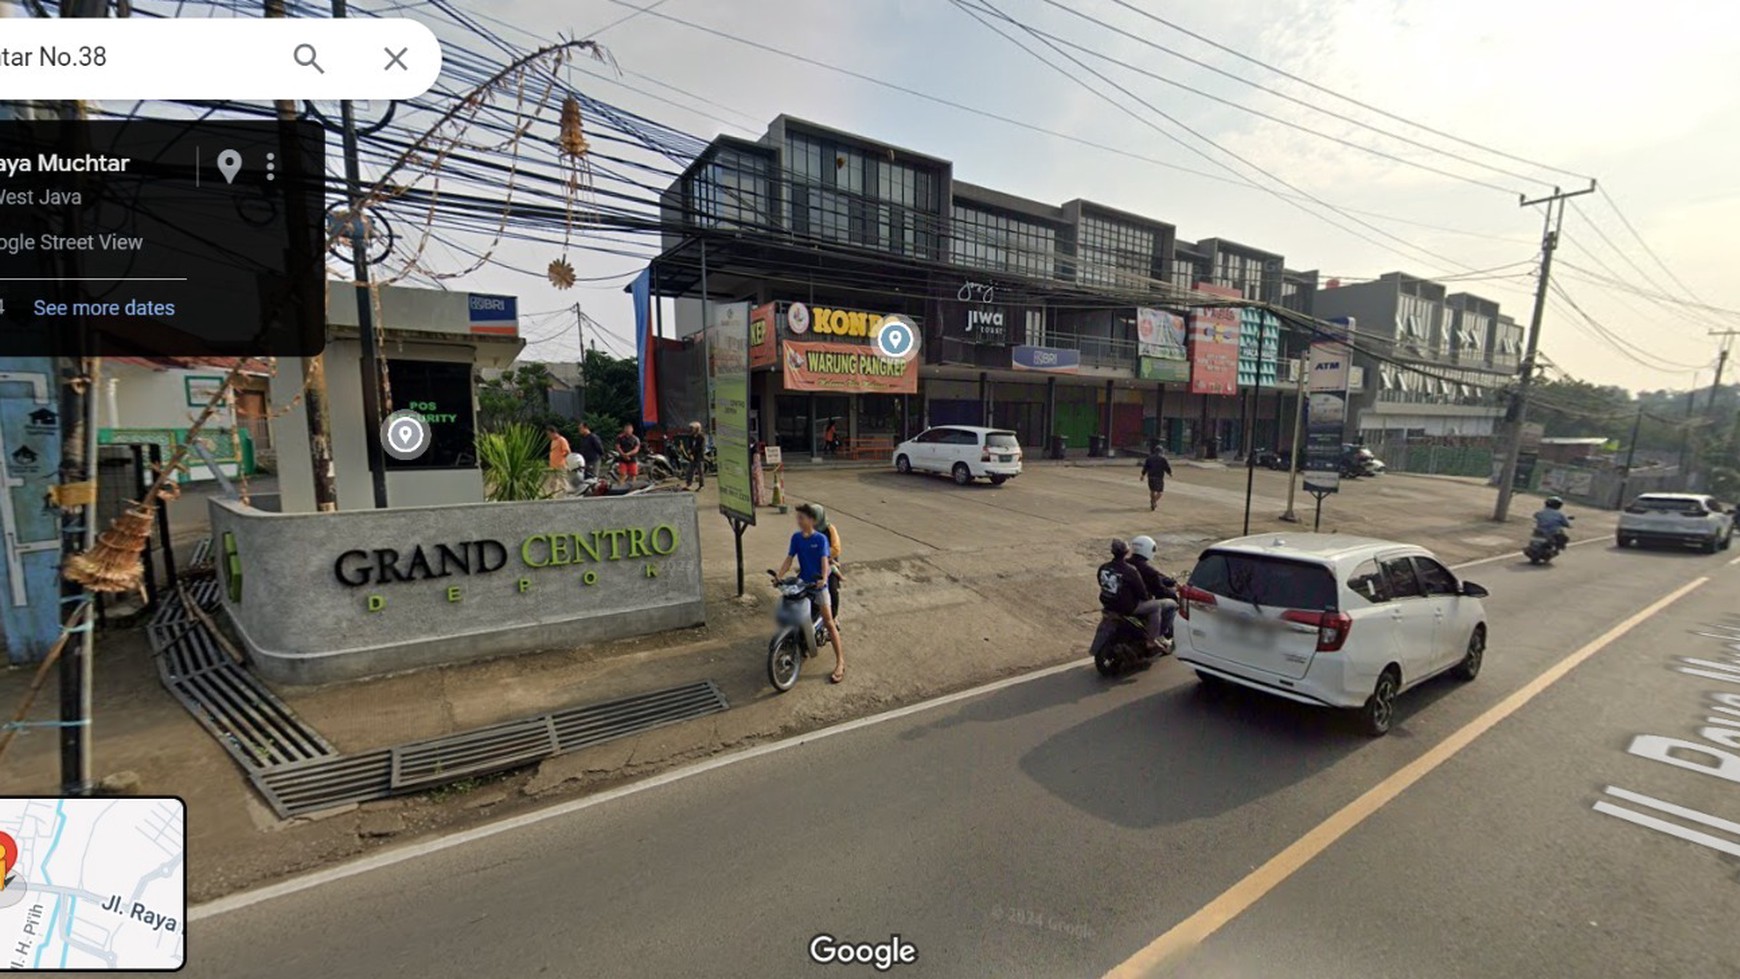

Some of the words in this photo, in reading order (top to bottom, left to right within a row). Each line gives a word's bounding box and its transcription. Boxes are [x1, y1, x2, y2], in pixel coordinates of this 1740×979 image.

[806, 351, 857, 374] WARUNG
[859, 354, 907, 377] PANGKEP
[1315, 361, 1340, 371] ATM
[409, 401, 437, 412] POS
[334, 539, 509, 587] GRAND
[521, 523, 680, 569] CENTRO
